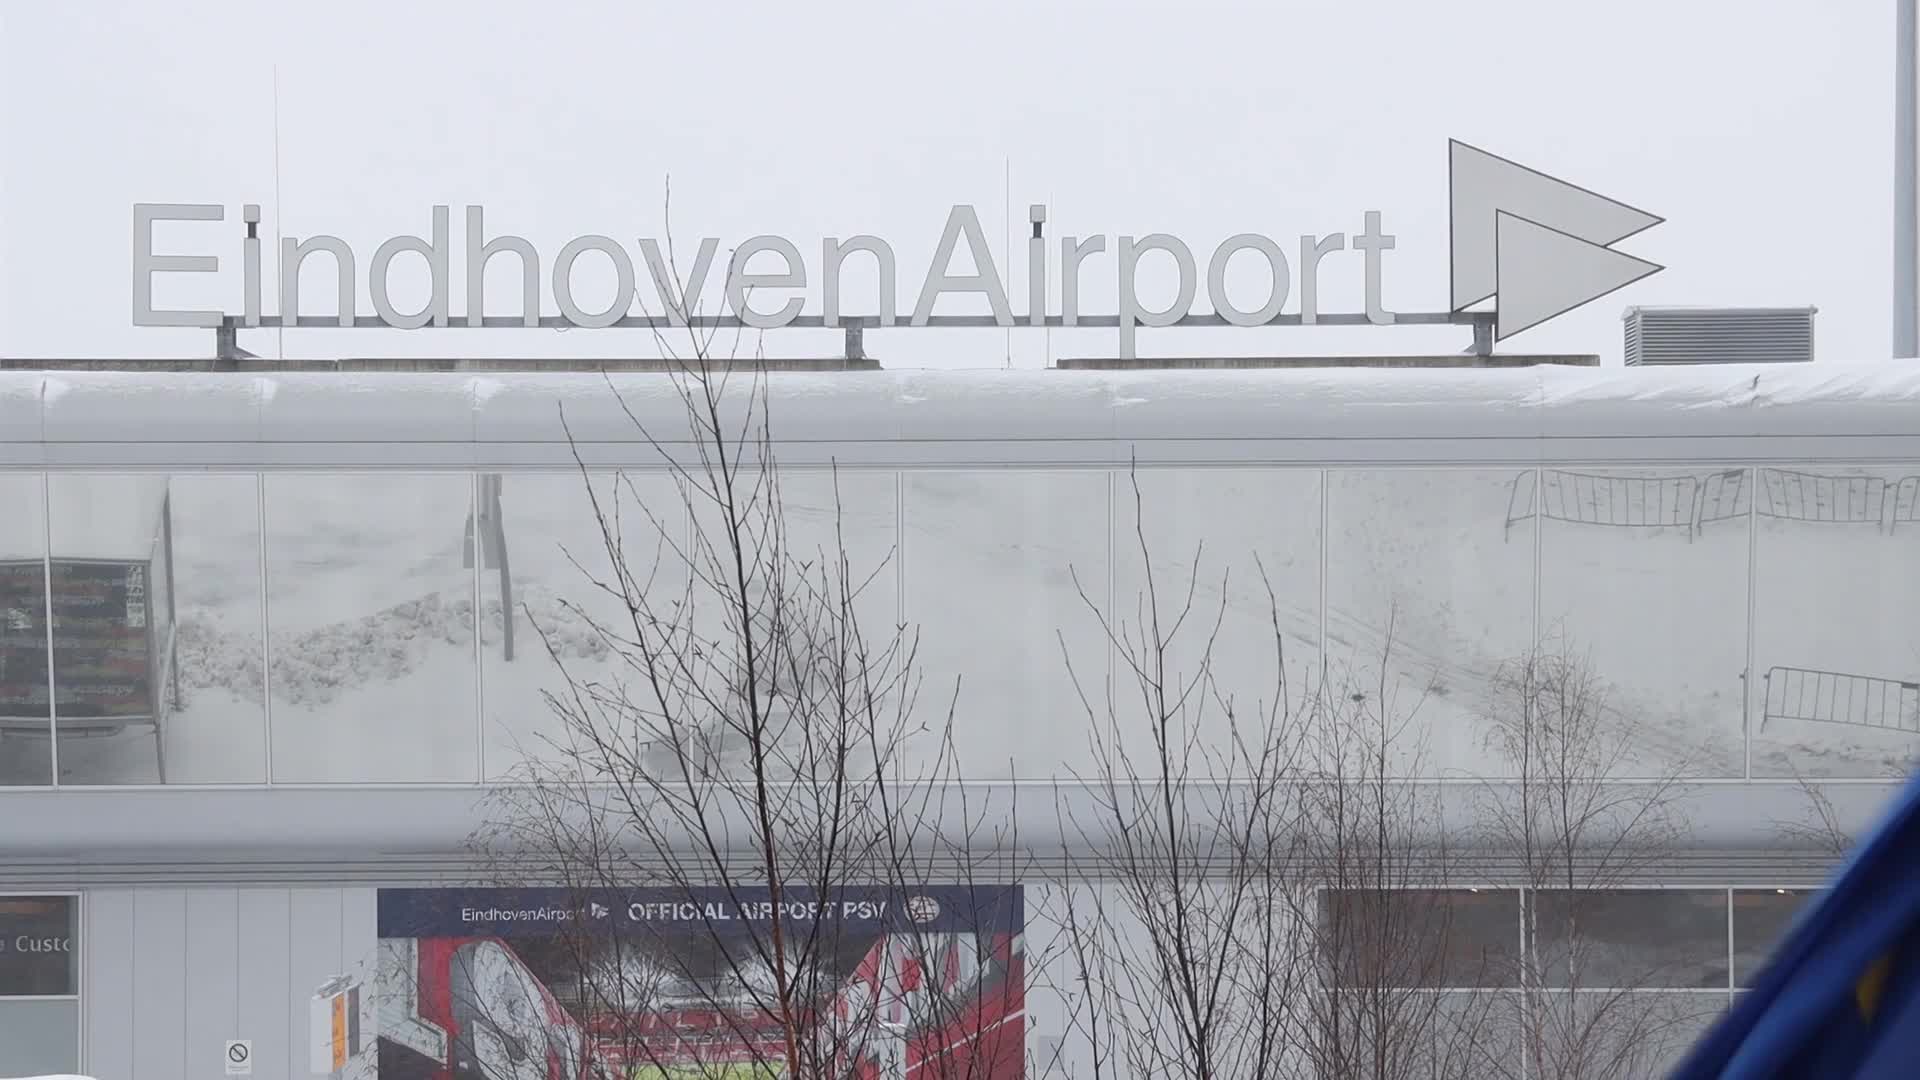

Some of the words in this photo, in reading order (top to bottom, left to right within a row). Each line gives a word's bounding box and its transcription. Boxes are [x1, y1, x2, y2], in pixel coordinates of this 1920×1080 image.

[133, 203, 1396, 360] EindhovenAirport
[462, 905, 585, 923] EindhovenAirpo
[628, 902, 730, 920] OFFICIAL
[736, 902, 837, 920] AIRPORT
[843, 901, 886, 920] PSV
